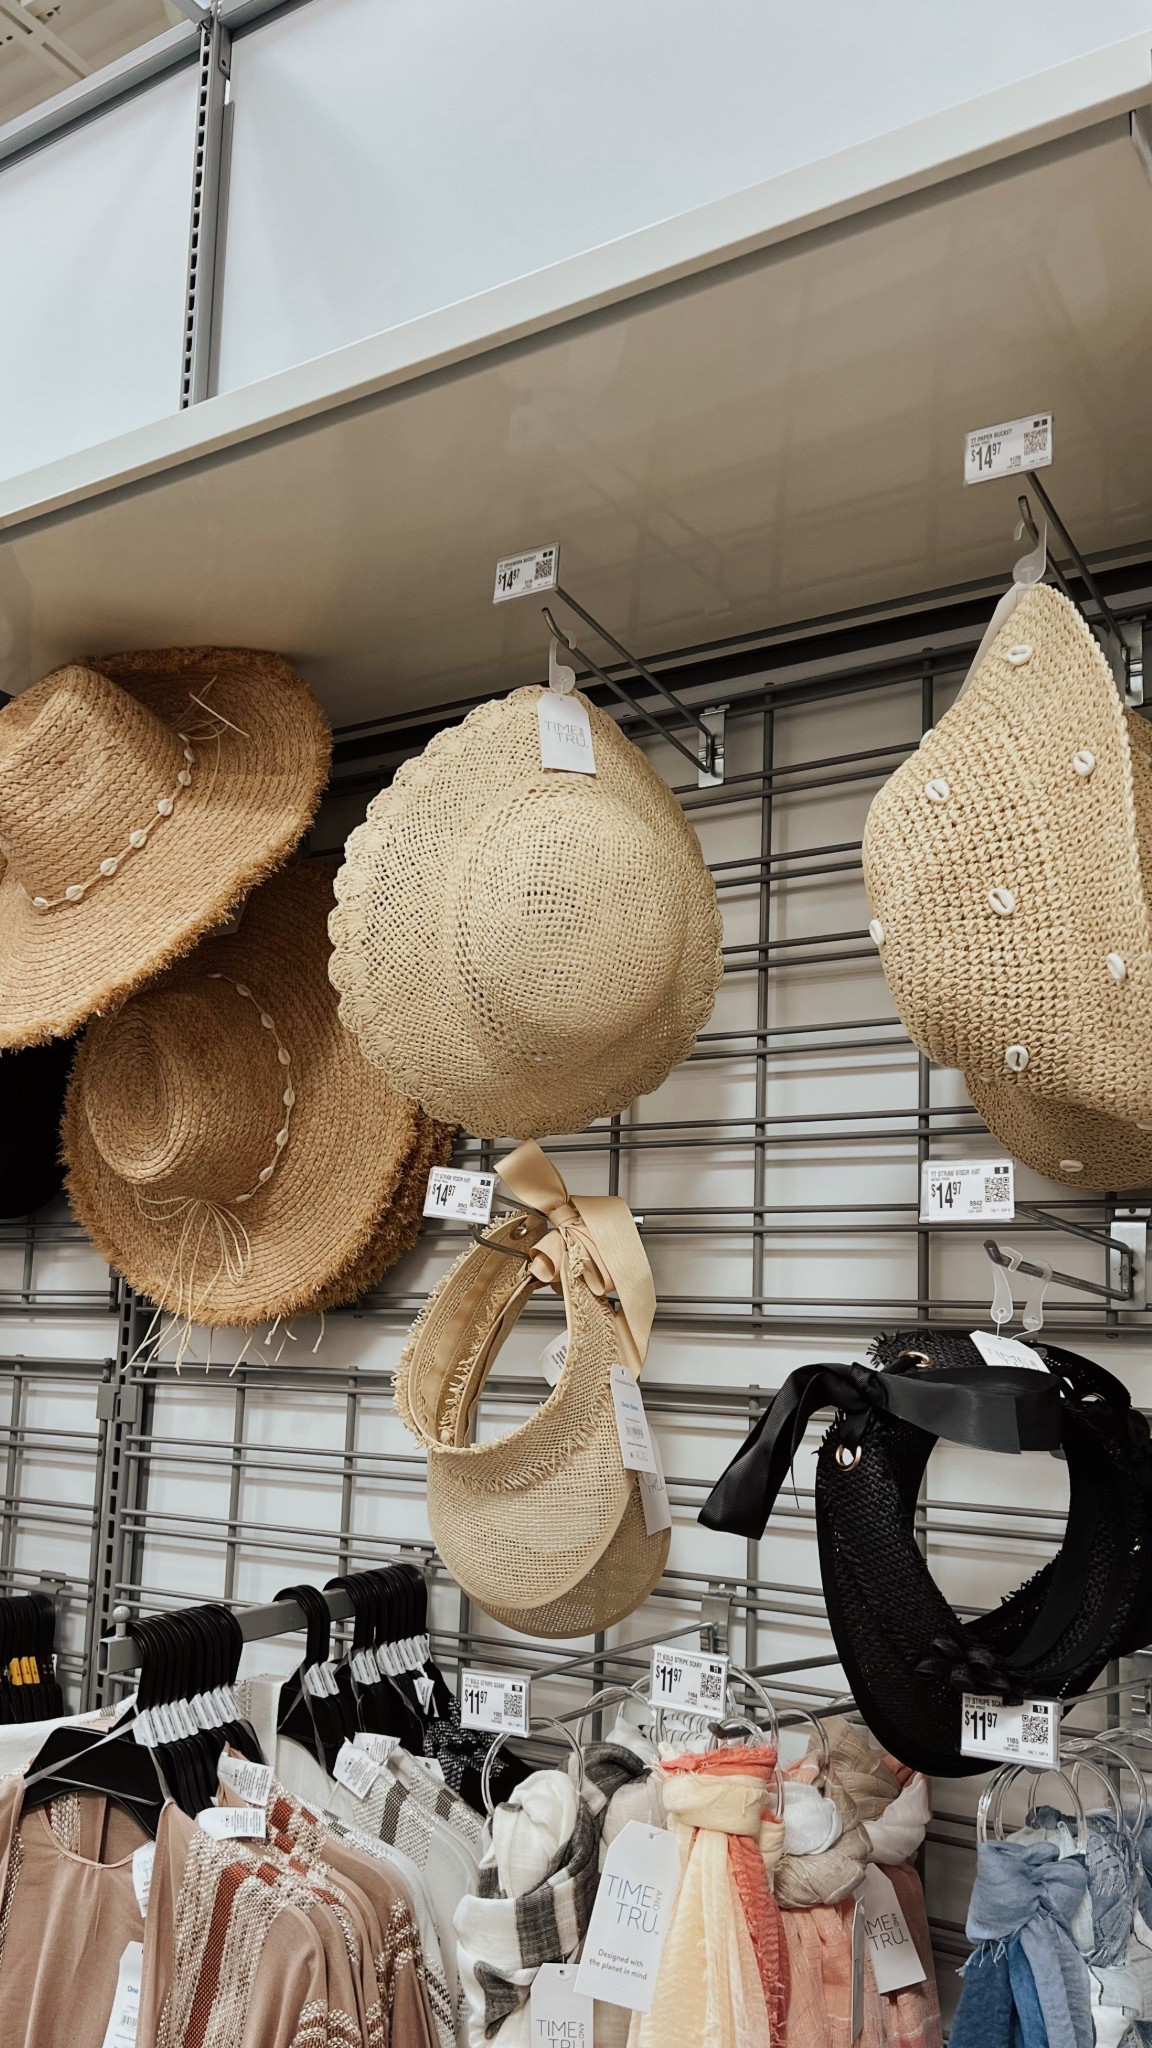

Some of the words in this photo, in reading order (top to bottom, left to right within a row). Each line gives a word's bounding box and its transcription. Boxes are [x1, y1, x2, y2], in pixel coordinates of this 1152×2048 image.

[544, 721, 578, 735] TIME
[555, 732, 586, 748] TRU
[972, 1697, 990, 1706] STRIPE
[606, 1874, 655, 1908] TIME
[652, 1890, 664, 1912] AND
[616, 1901, 659, 1935] TRU
[864, 1914, 892, 1936] IME
[868, 1929, 906, 1950] TRU
[598, 1948, 629, 1964] Designed
[630, 1958, 644, 1968] with
[590, 1958, 600, 1968] the
[602, 1961, 623, 1974] planet
[624, 1966, 630, 1975] in
[631, 1970, 648, 1980] mind
[128, 1985, 138, 1994] One
[536, 2019, 578, 2038] TIME
